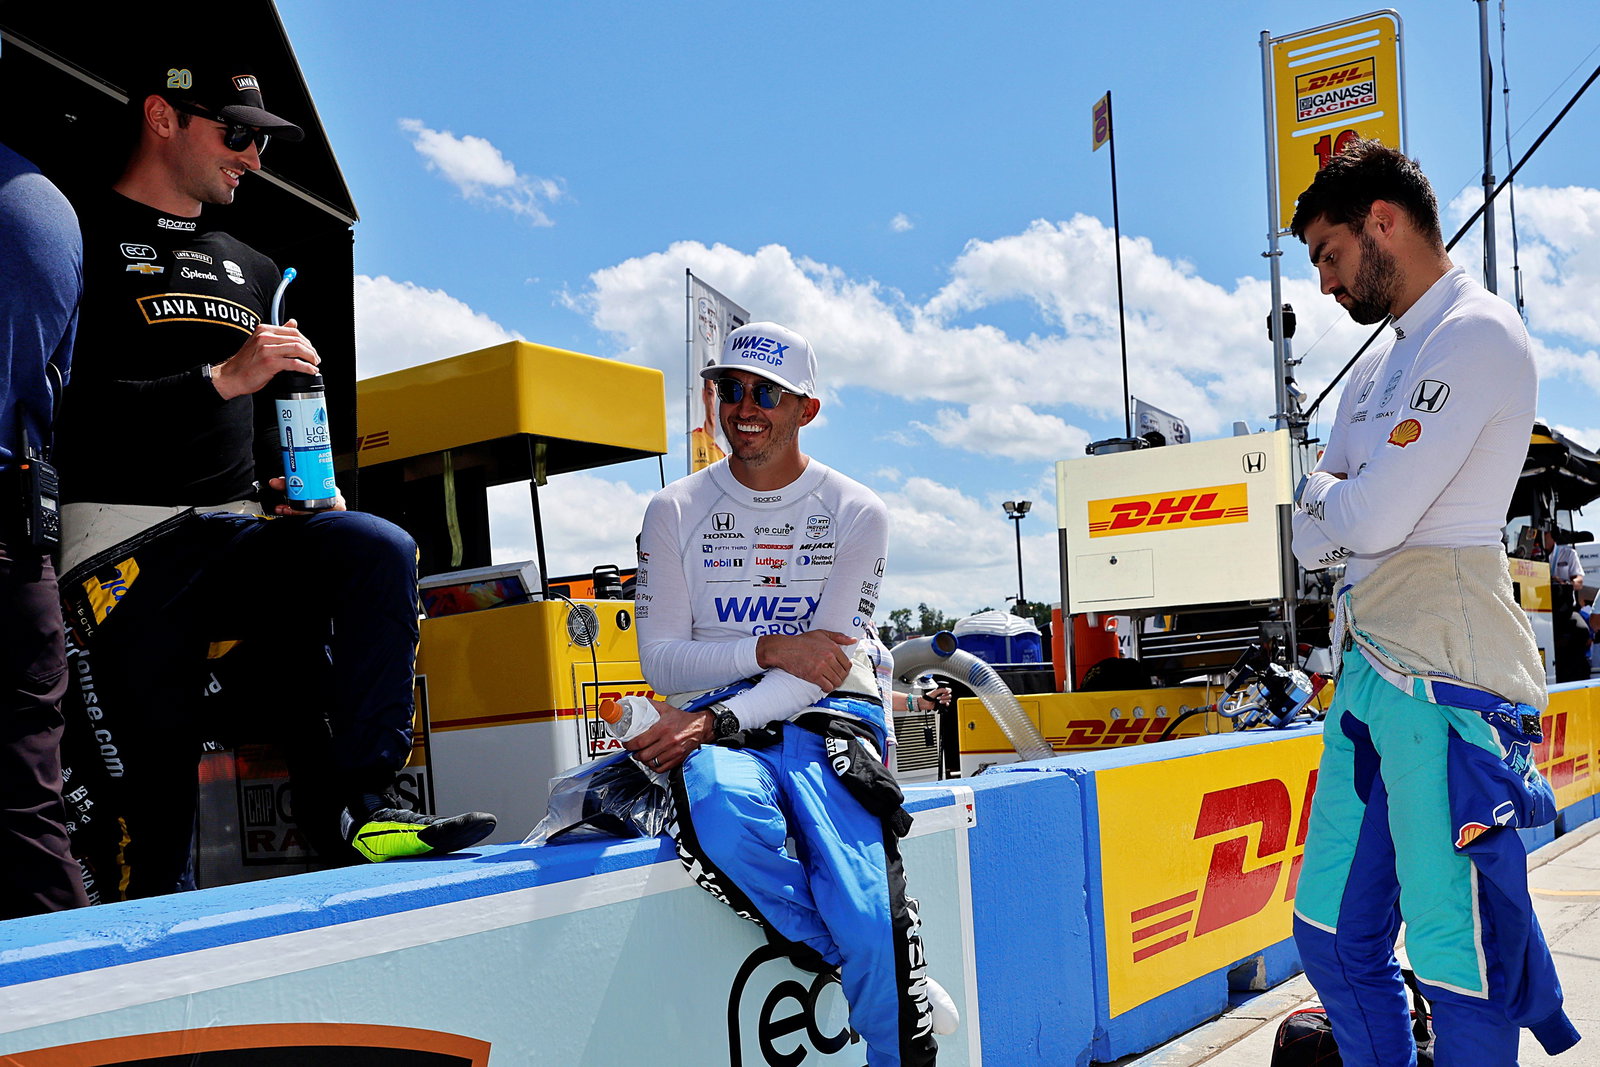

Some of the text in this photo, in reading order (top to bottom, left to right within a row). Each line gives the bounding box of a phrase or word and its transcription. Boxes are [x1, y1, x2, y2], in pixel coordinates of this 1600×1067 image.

[167, 68, 192, 89] 20
[1308, 67, 1363, 91] DHL
[1313, 82, 1373, 106] GANASSI
[1300, 95, 1374, 118] RACING
[157, 218, 197, 231] sparco
[180, 266, 219, 281] Splenda
[153, 299, 256, 331] JAVA HOUSE
[741, 350, 783, 367] GROUP
[282, 409, 292, 419] 20
[1109, 492, 1226, 530] DHL
[754, 526, 770, 536] one
[771, 527, 790, 535] cure
[704, 558, 731, 567] Mobil
[755, 557, 784, 566] Luther
[1064, 717, 1178, 746] DHL
